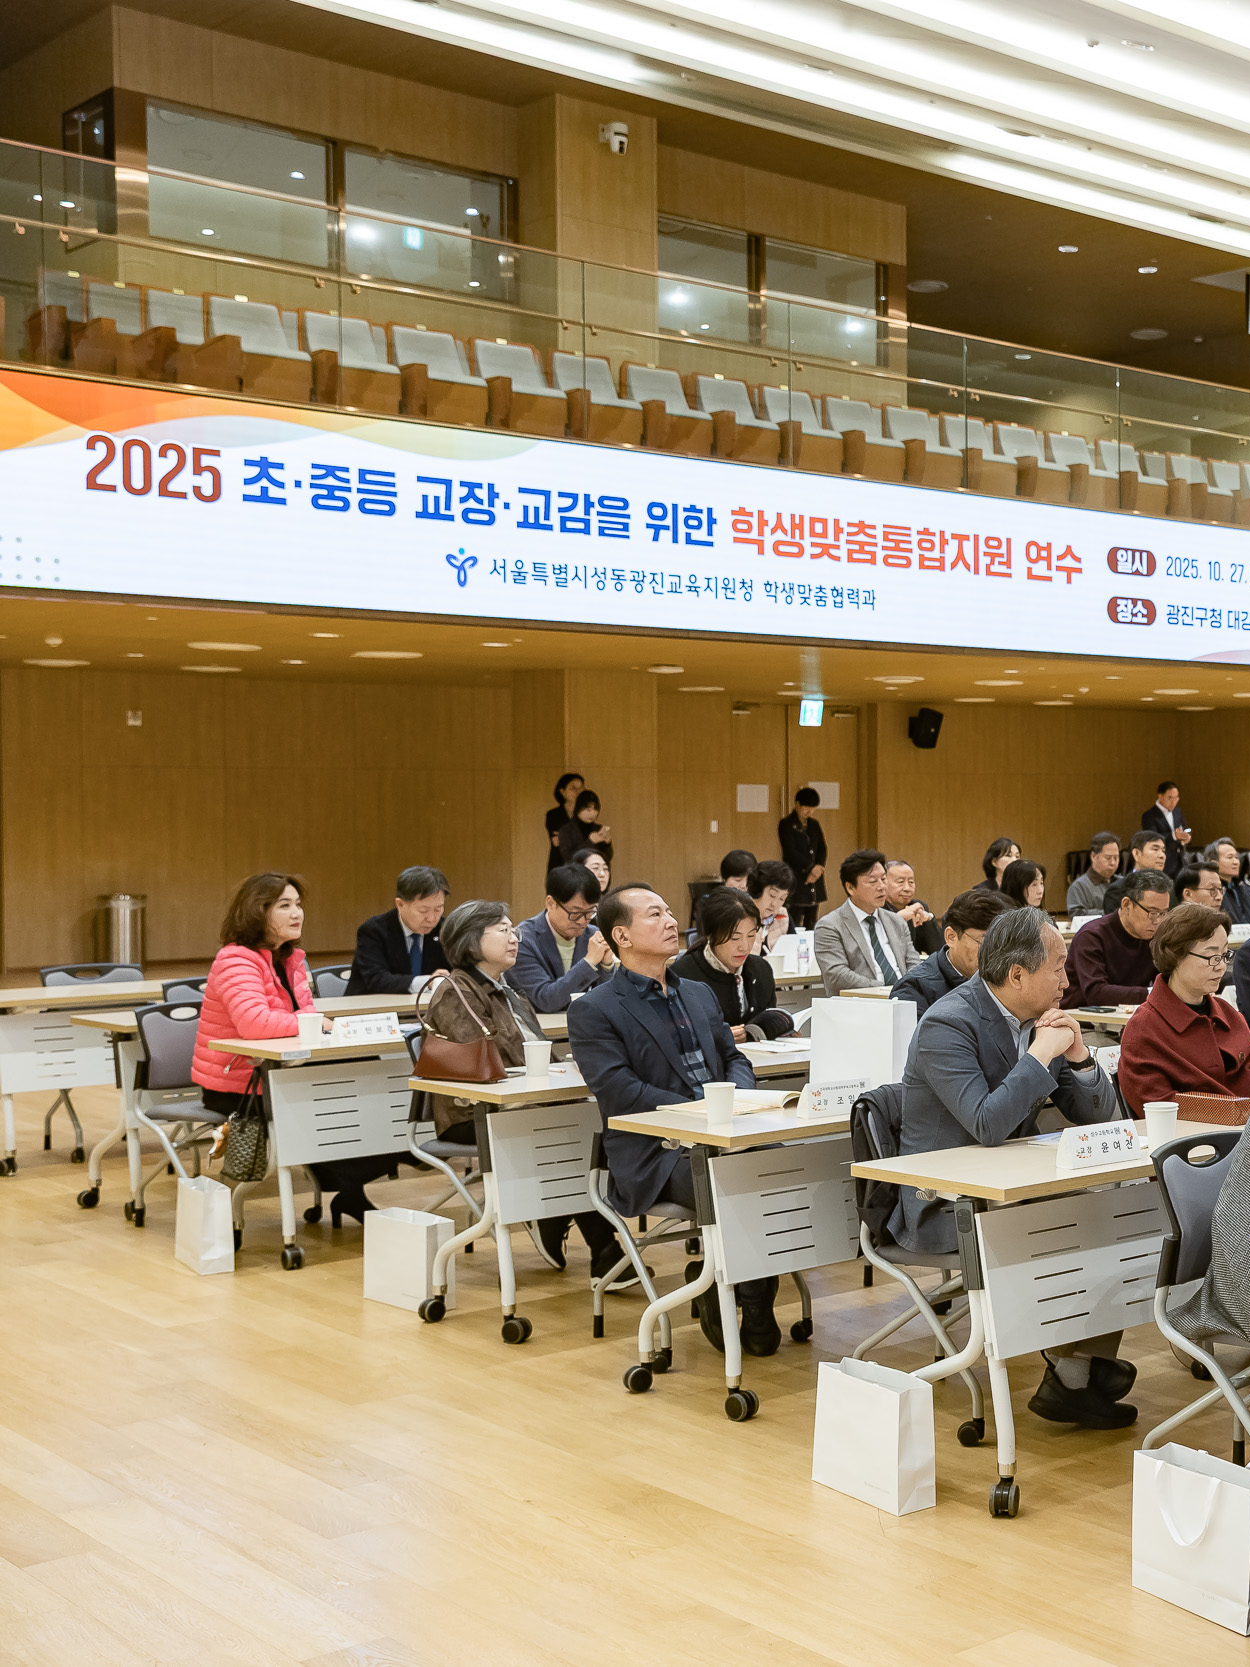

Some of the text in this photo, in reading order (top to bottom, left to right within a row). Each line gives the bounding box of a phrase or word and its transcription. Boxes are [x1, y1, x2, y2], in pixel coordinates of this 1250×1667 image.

[85, 433, 1084, 585] 2025 초·중등 교장·교감을 위한 학생맞춤통합지원 연수
[489, 558, 877, 612] 서울특별시성동광진교육지원청 학생맞춤협력과
[1116, 549, 1148, 574] 일시
[1165, 556, 1202, 580] 2025.
[1208, 561, 1225, 582] 10.
[1116, 599, 1148, 624] 장소
[1165, 604, 1223, 629] 광진구청
